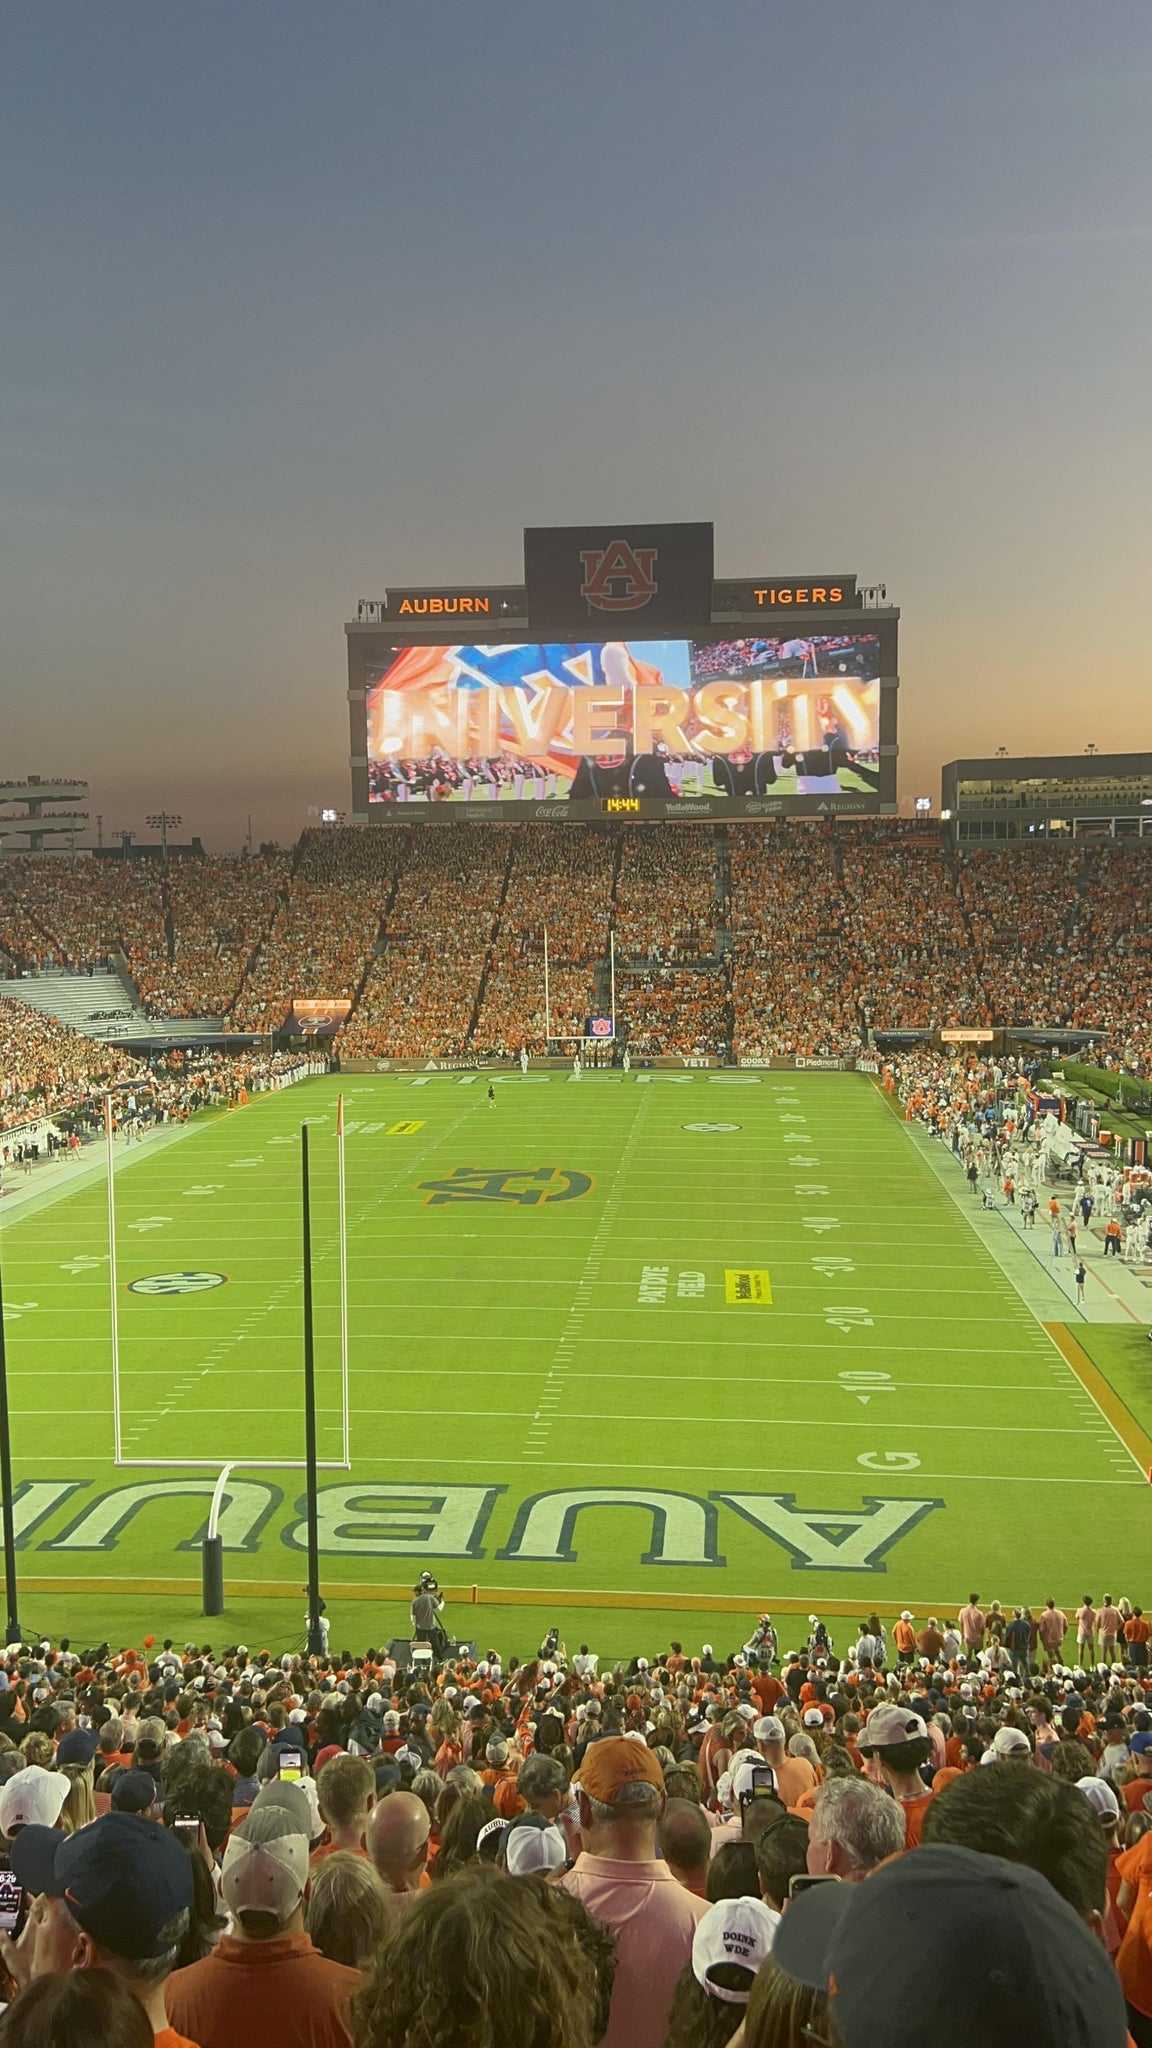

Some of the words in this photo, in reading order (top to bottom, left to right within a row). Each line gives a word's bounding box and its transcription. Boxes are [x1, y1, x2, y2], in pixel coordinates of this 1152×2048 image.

[580, 539, 658, 612] AU
[753, 588, 843, 605] TIGERS
[398, 598, 489, 614] AUBURN
[607, 798, 639, 811] 14:44
[665, 802, 710, 811] YellaWood
[830, 802, 866, 811] REGIONS
[916, 798, 931, 810] 25
[440, 1061, 478, 1070] REGION
[682, 1058, 709, 1067] YETI
[806, 1058, 838, 1066] Piedmont
[396, 1074, 765, 1086] TIGERS
[801, 1216, 841, 1229] 40
[59, 1254, 110, 1270] 30
[810, 1256, 856, 1272] 30
[676, 1271, 705, 1298] FIELD
[822, 1306, 875, 1326] 20
[837, 1370, 896, 1391] 10
[856, 1451, 922, 1471] G
[722, 1931, 757, 1947] DOINK
[724, 1944, 750, 1957] WDE
